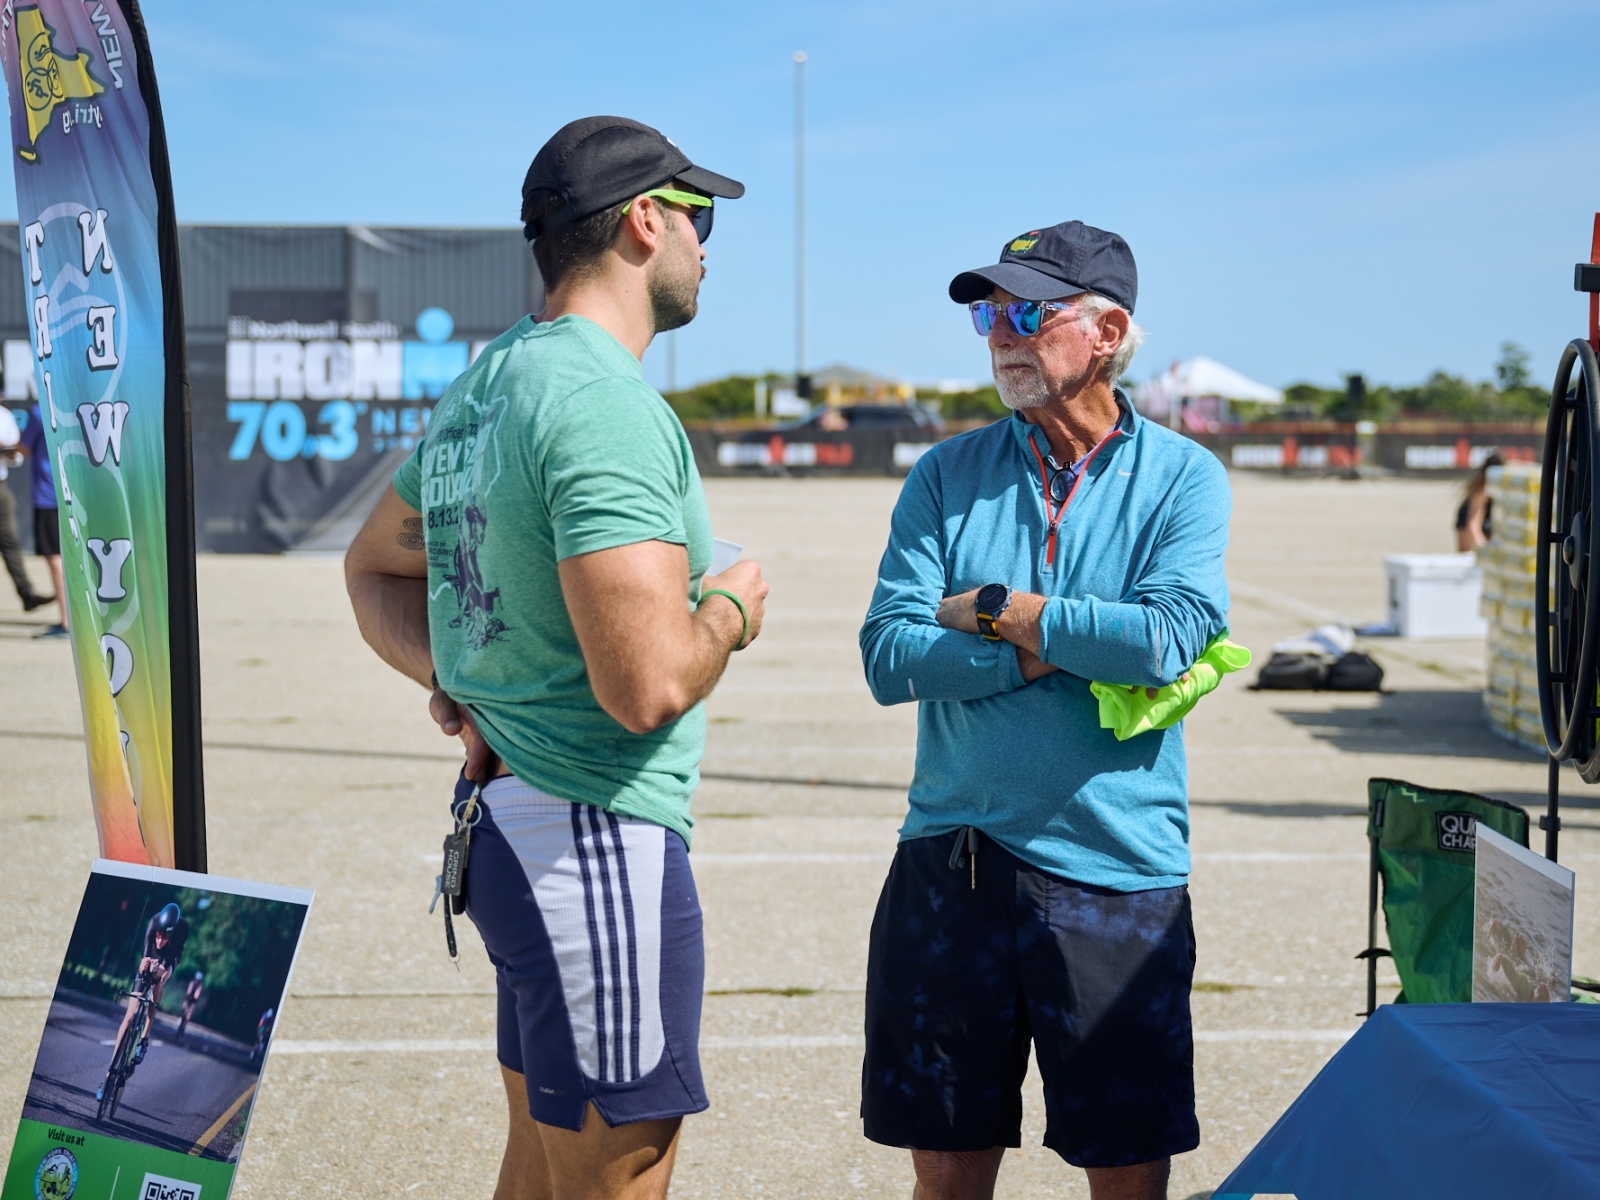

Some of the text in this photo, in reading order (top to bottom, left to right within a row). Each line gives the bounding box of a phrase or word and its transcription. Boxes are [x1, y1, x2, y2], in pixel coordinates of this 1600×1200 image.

[444, 849, 454, 889] HOUSE
[450, 851, 460, 888] GRIND
[48, 1129, 85, 1146] Visit us at
